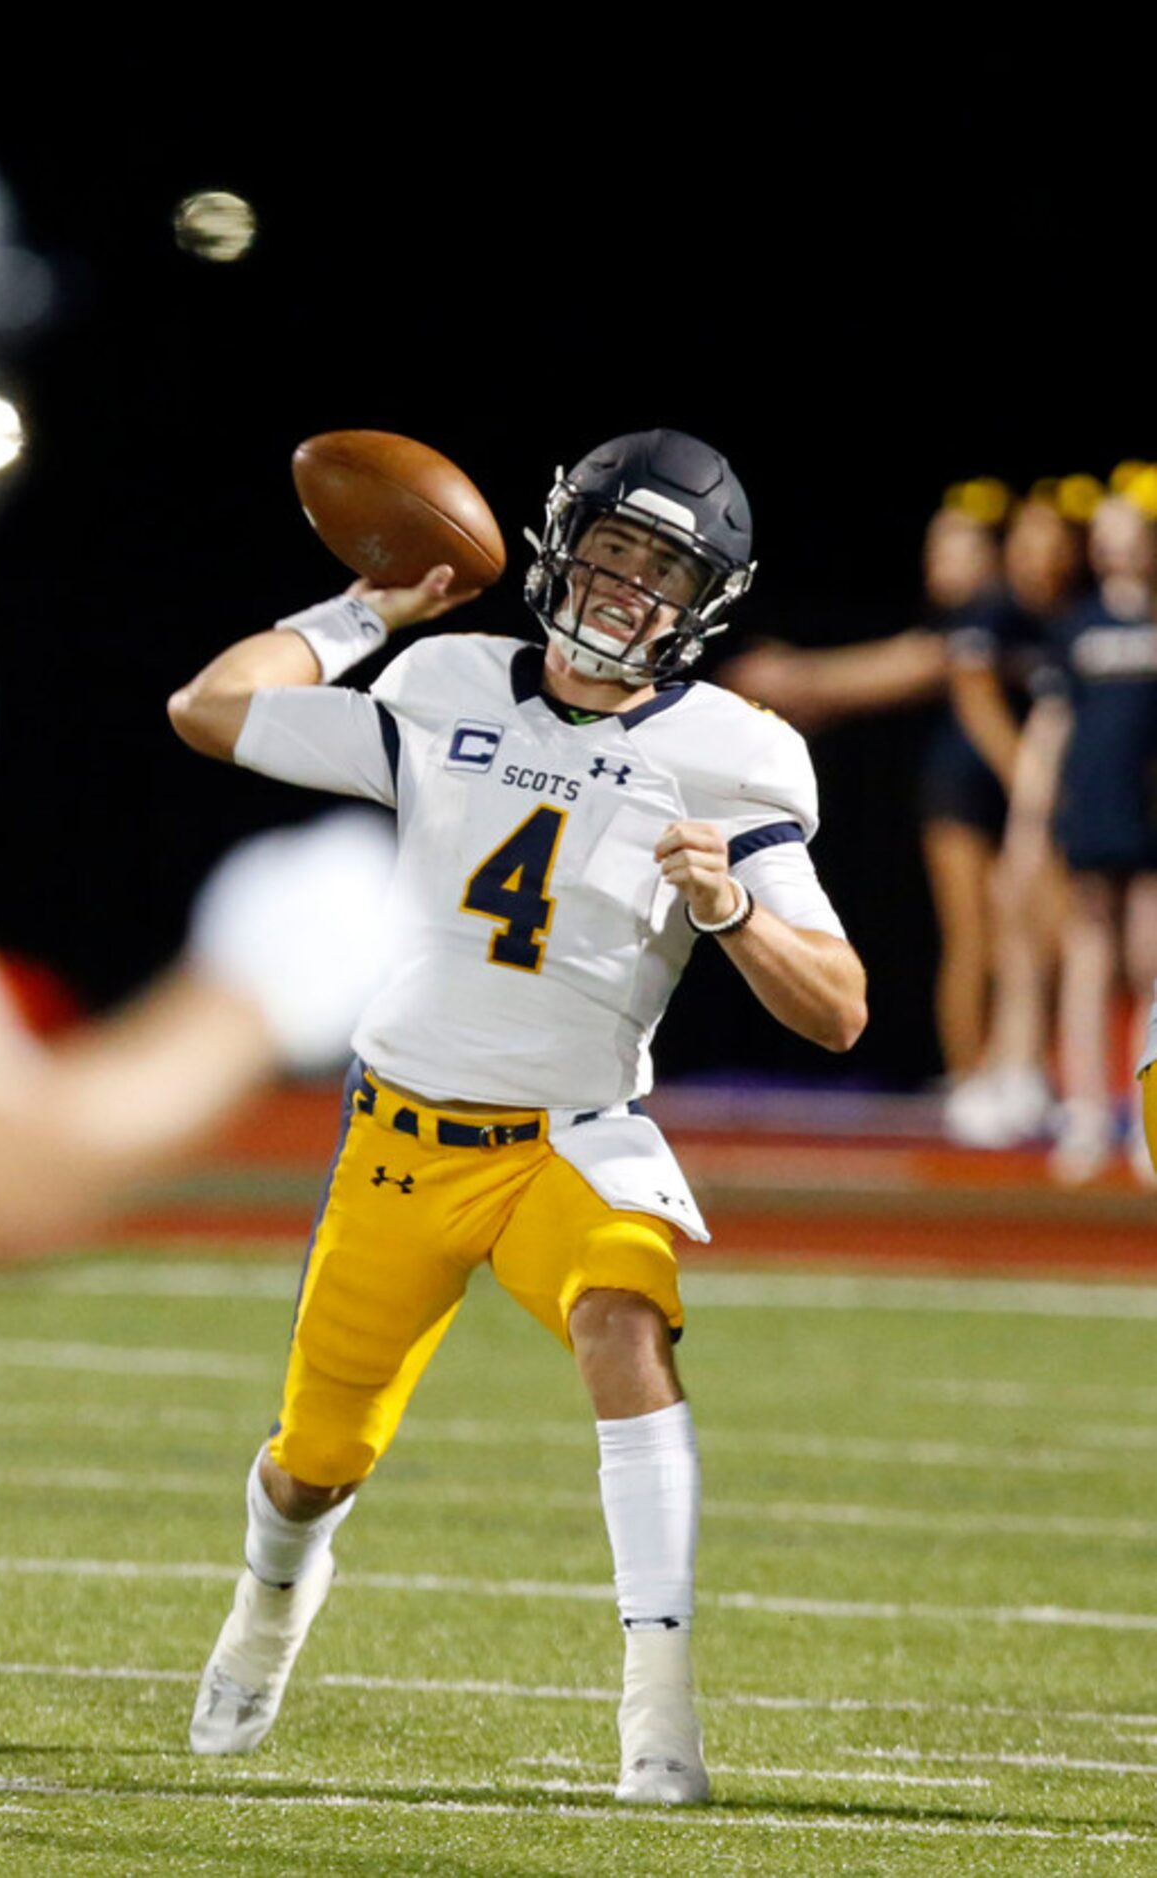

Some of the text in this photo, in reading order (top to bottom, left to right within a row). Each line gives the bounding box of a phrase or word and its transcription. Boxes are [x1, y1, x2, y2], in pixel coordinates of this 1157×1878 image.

[449, 728, 499, 764] C
[501, 764, 581, 801] SCOTS
[459, 802, 569, 974] 4
